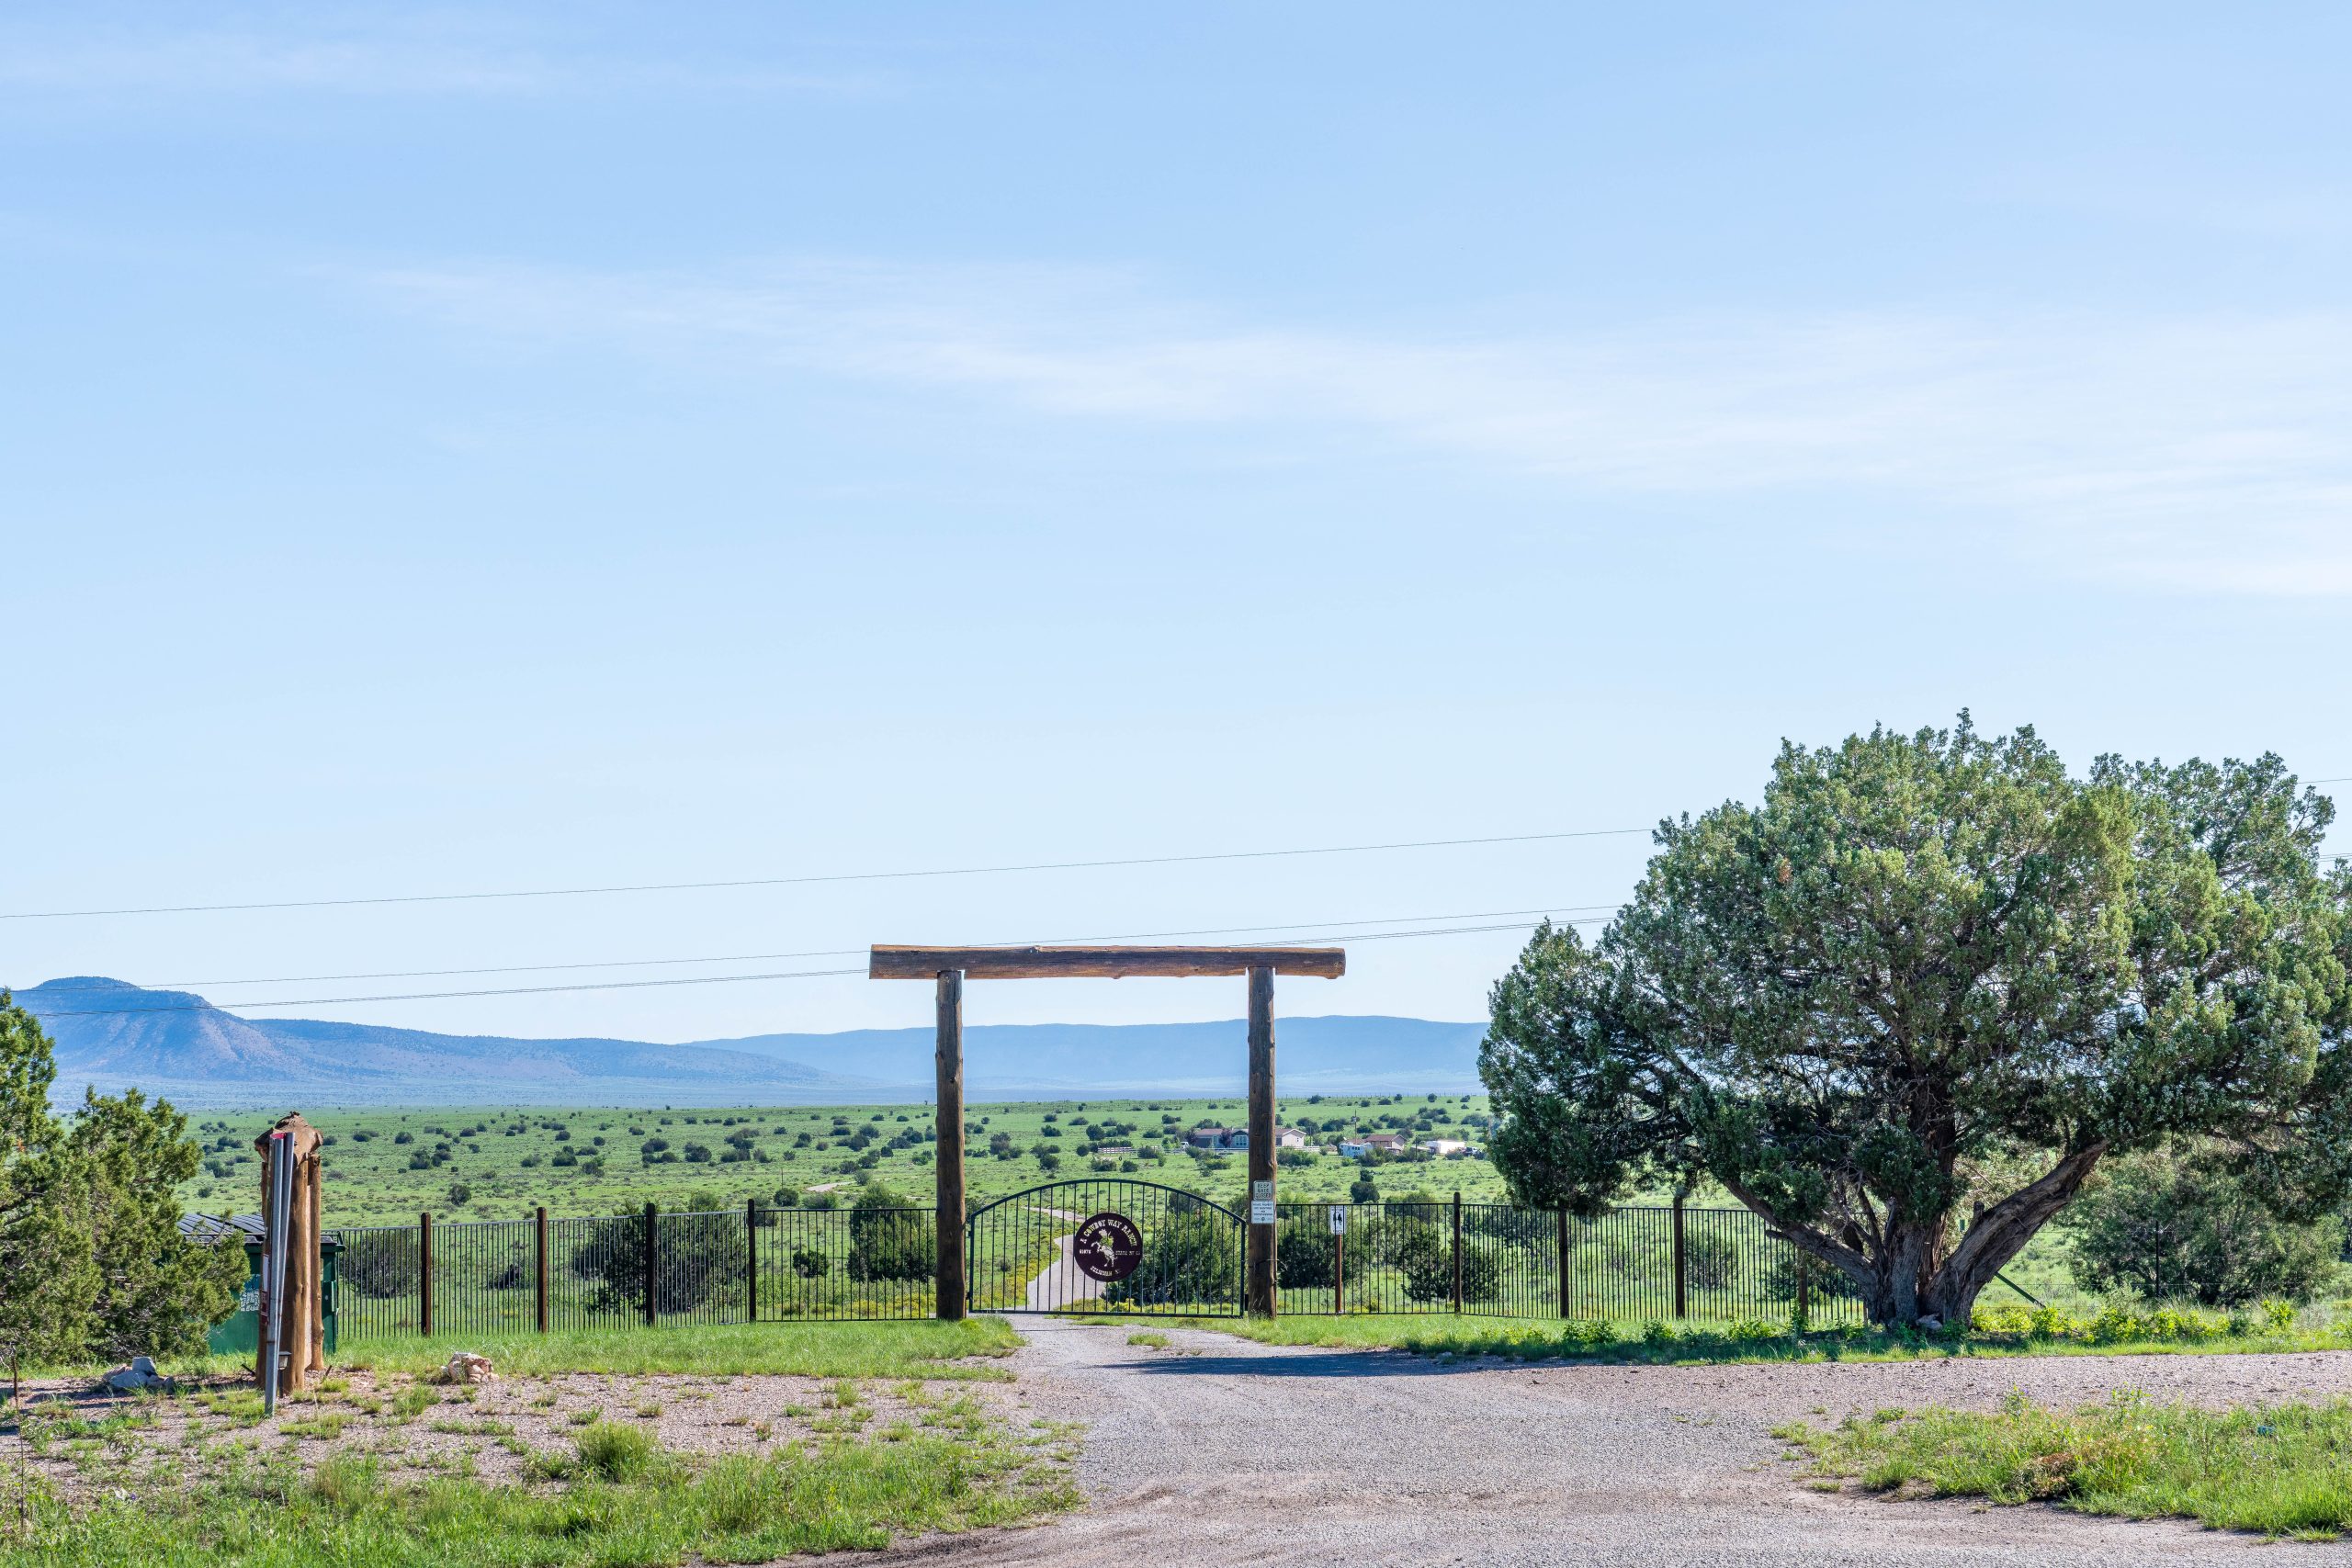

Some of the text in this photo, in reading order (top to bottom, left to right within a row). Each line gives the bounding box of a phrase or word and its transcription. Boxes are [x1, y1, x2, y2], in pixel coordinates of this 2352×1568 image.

[1083, 1219, 1106, 1237] COWBOY
[1107, 1219, 1122, 1229] WAY
[1121, 1224, 1138, 1247] RANCH
